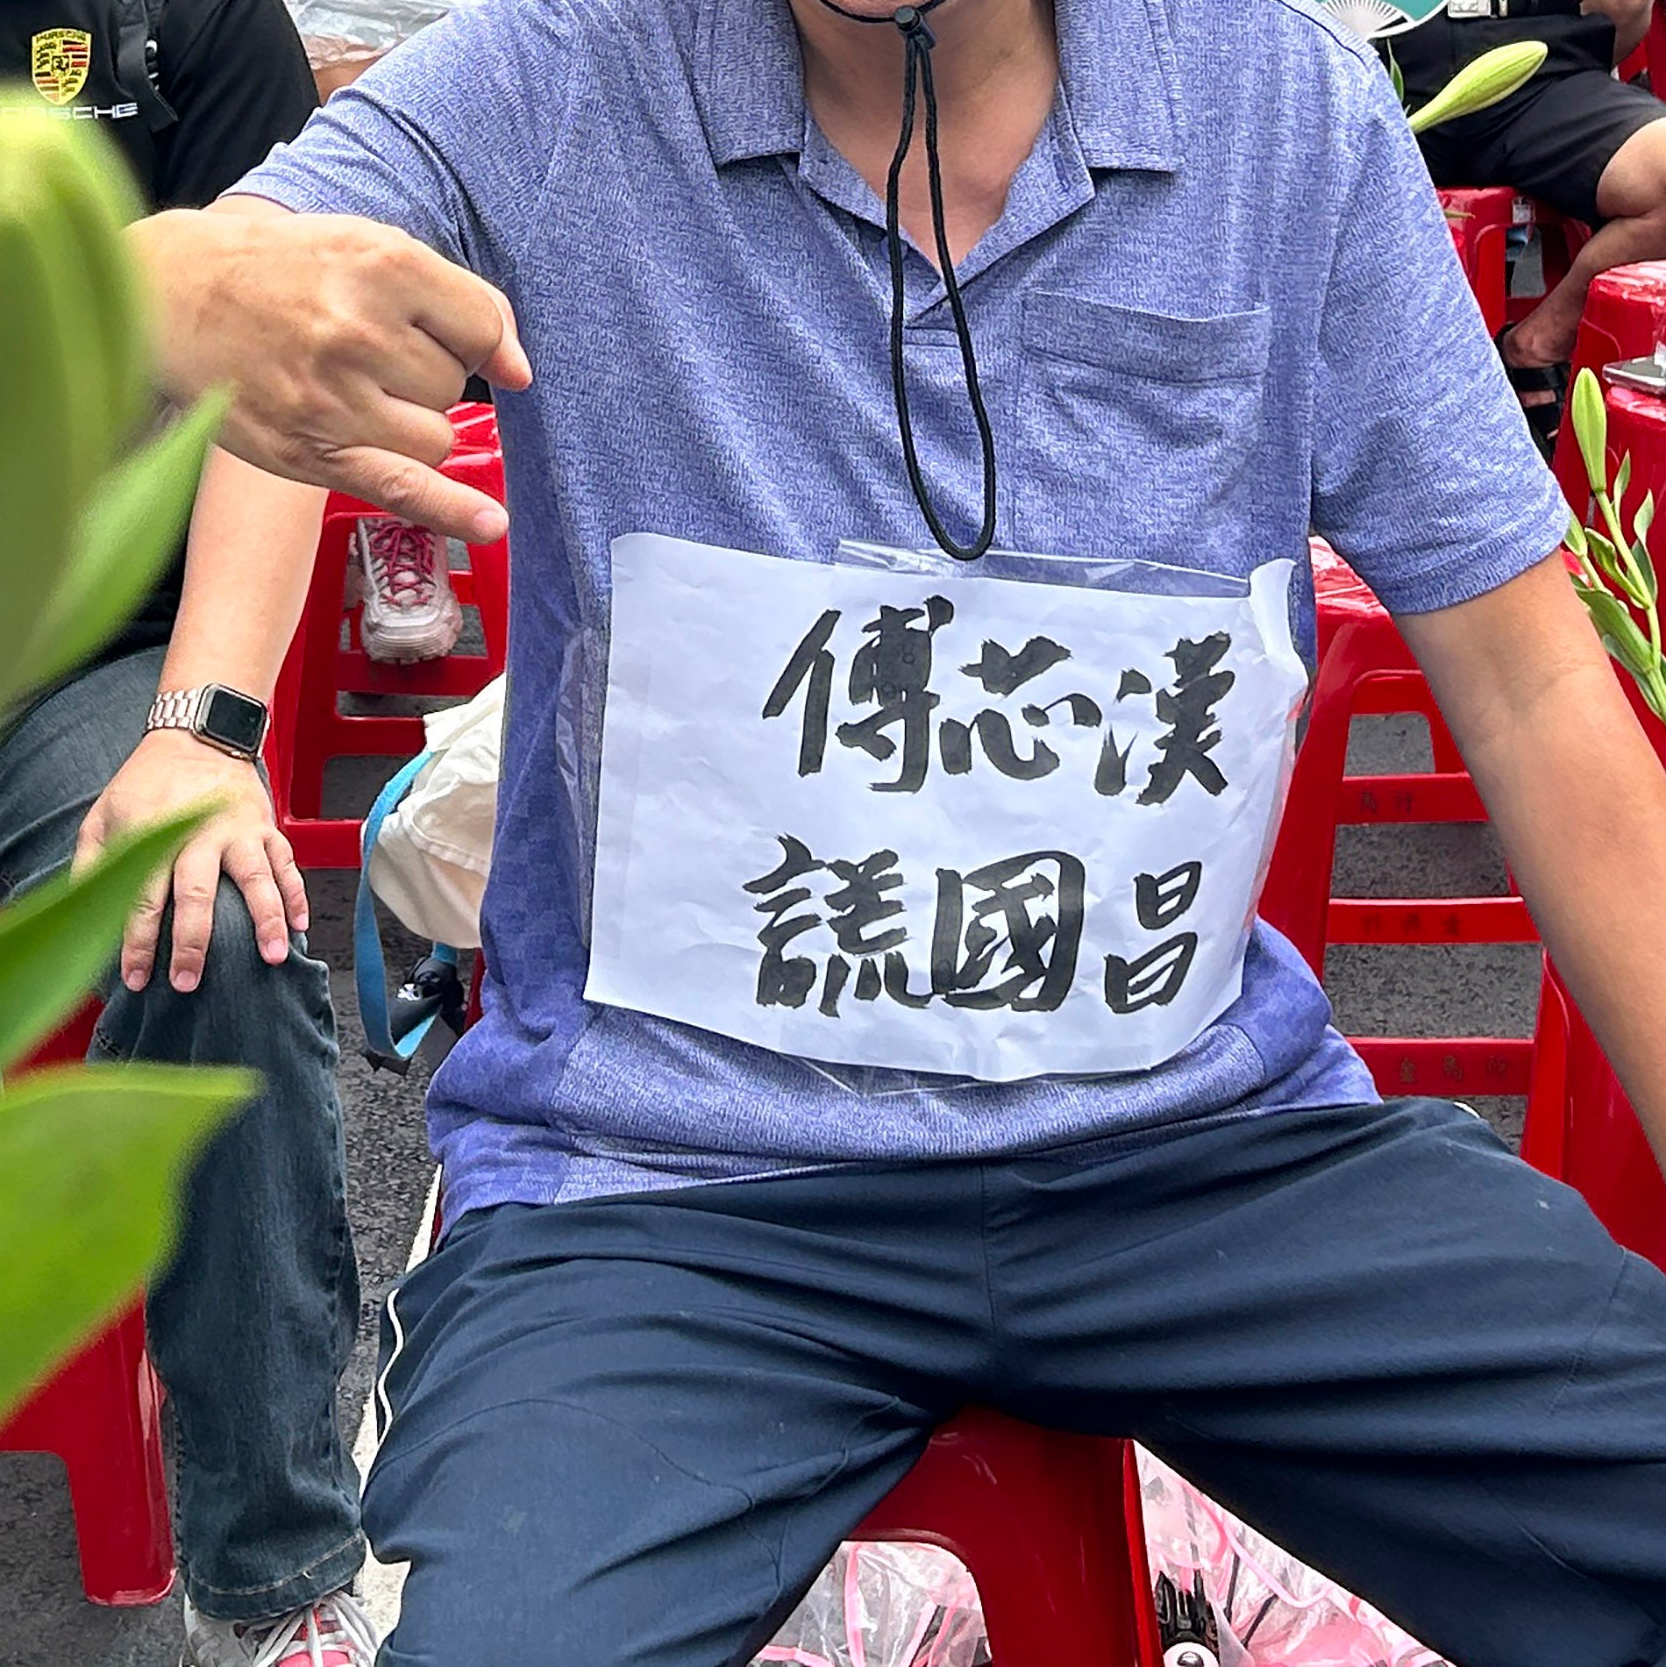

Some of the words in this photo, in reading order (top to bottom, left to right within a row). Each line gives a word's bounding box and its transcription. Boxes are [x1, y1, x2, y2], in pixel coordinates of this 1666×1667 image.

[763, 594, 1235, 805] 傅芯漢
[742, 834, 1202, 1017] 謊國昌
